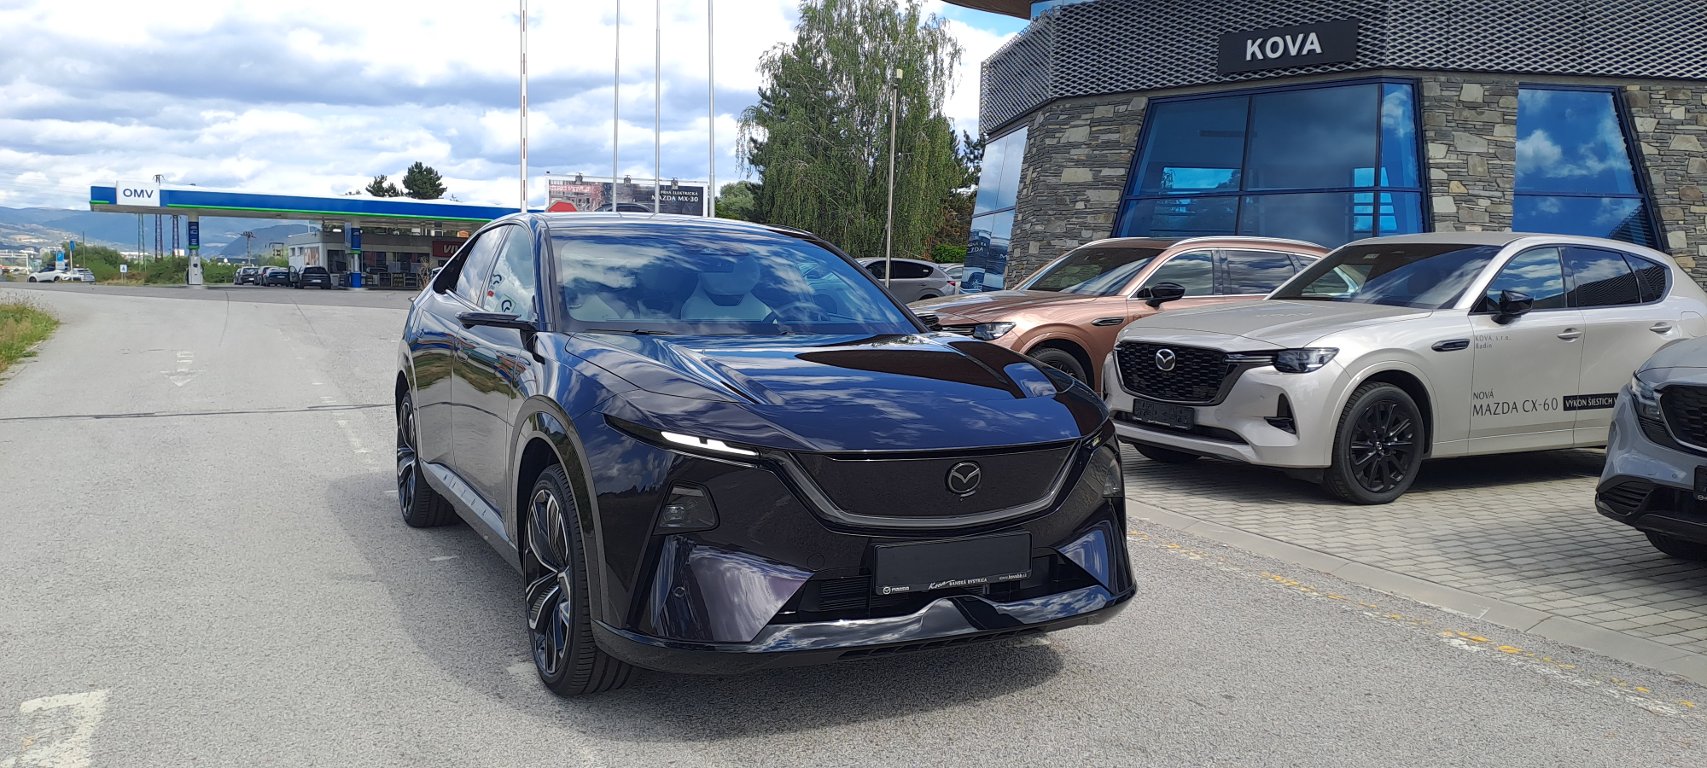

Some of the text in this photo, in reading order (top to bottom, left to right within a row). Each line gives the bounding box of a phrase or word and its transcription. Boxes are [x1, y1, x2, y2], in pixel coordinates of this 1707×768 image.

[1246, 32, 1322, 60] KOVA
[123, 188, 154, 198] OMV
[1473, 389, 1494, 400] NOVÁ
[1473, 397, 1559, 416] MAZDA CX-60
